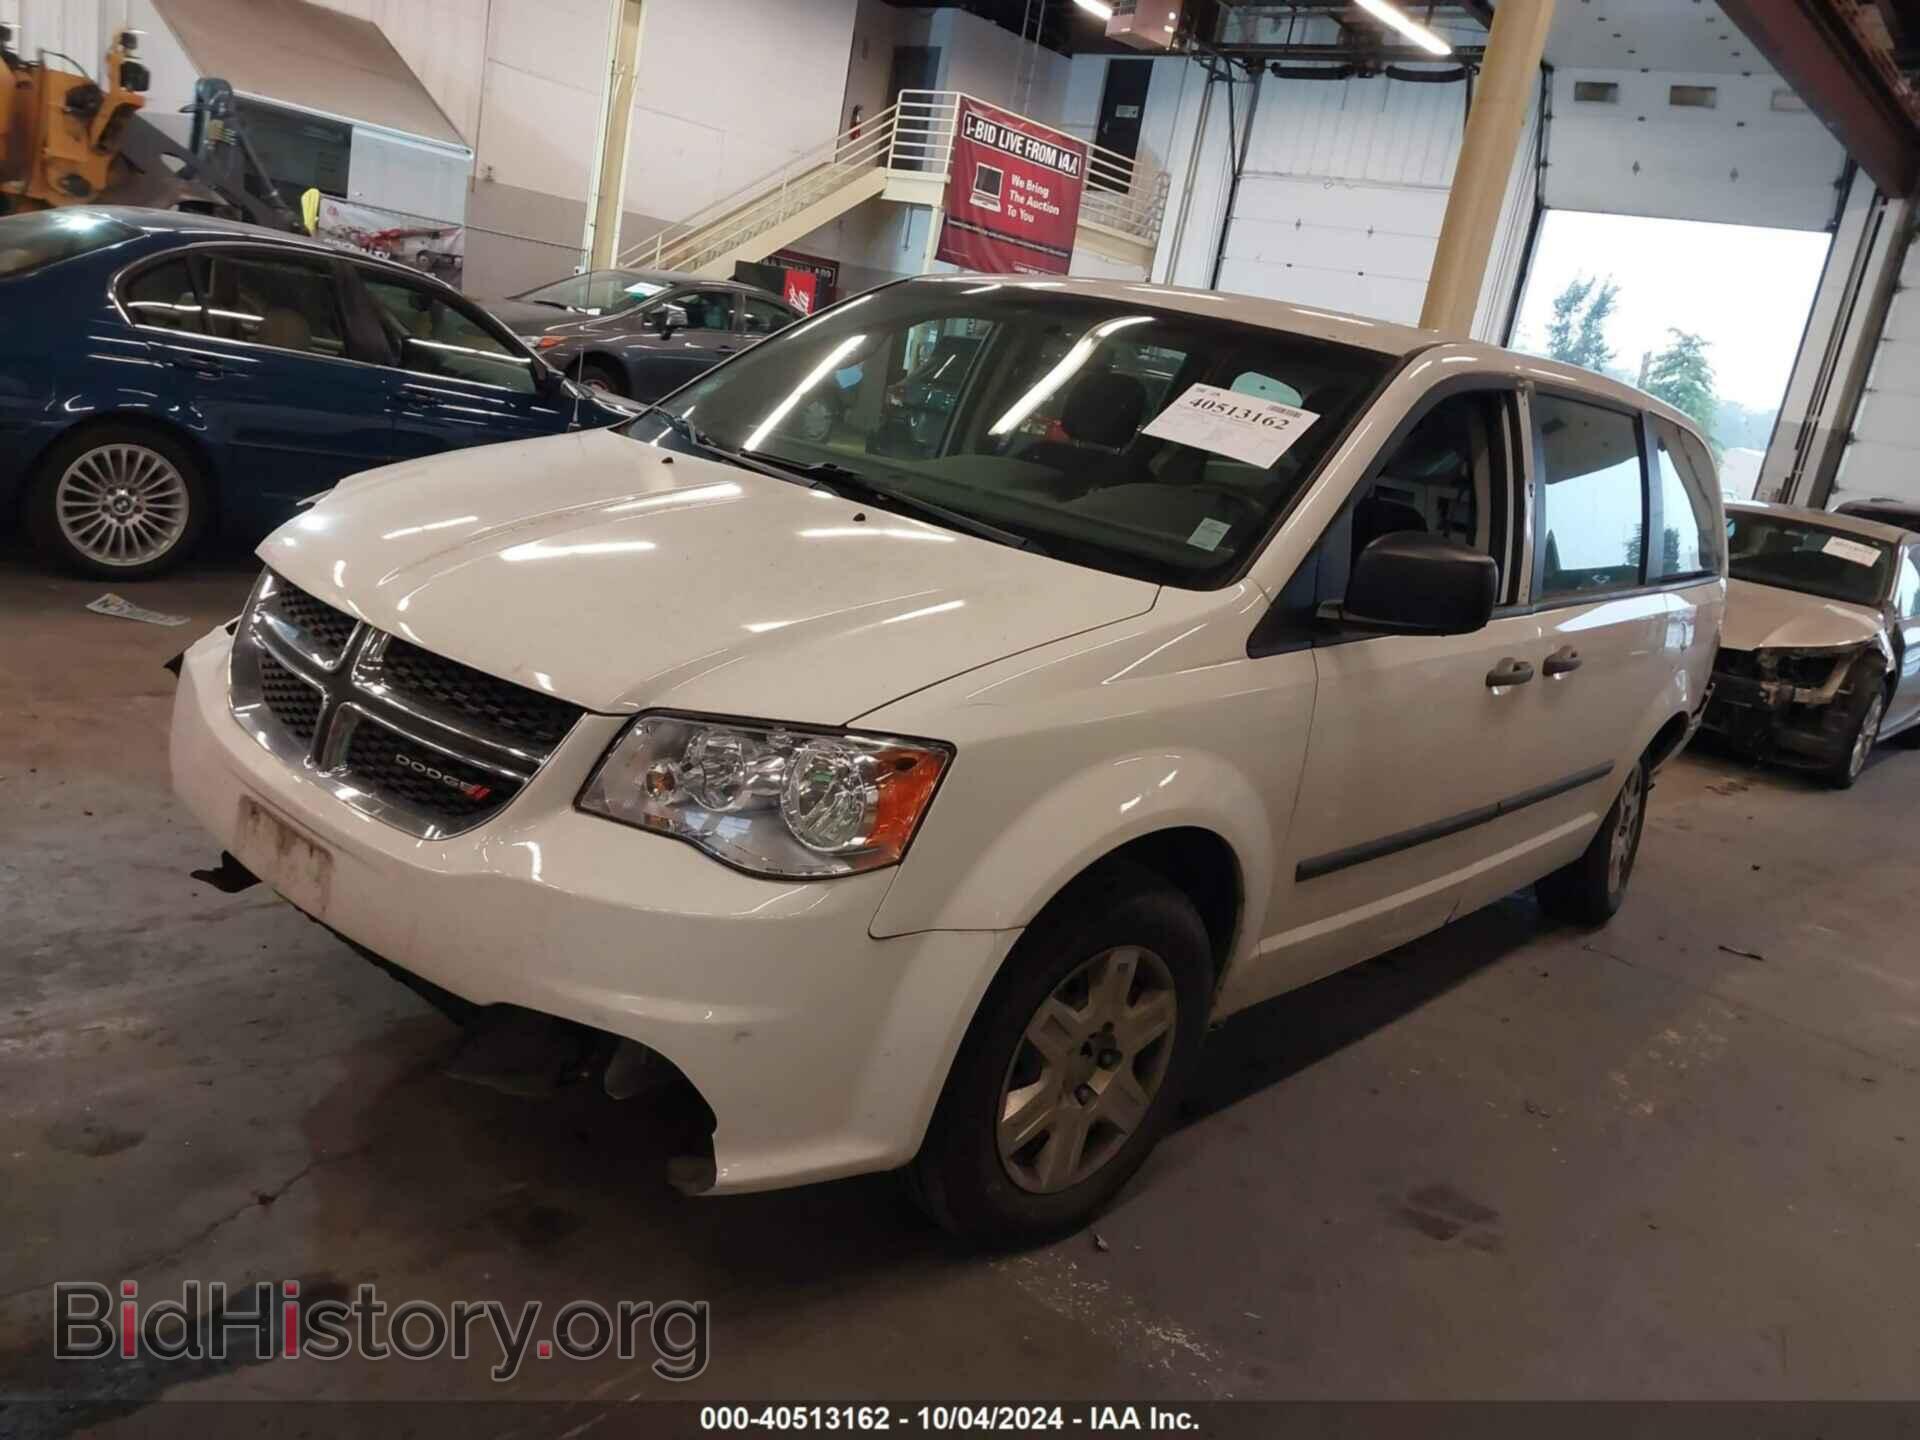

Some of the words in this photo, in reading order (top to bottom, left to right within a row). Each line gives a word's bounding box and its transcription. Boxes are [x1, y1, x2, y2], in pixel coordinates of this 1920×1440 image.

[966, 116, 996, 144] I-BID
[998, 129, 1025, 155] LIVE
[1024, 139, 1057, 168] FROM
[1057, 152, 1078, 175] IAA
[1011, 174, 1025, 188] We
[1026, 179, 1049, 199] Bring
[1008, 204, 1017, 218] To
[1019, 207, 1034, 223] You
[1010, 189, 1025, 204] The
[1026, 195, 1060, 216] Auction
[1189, 398, 1291, 430] 40513162
[396, 754, 475, 795] DODGE
